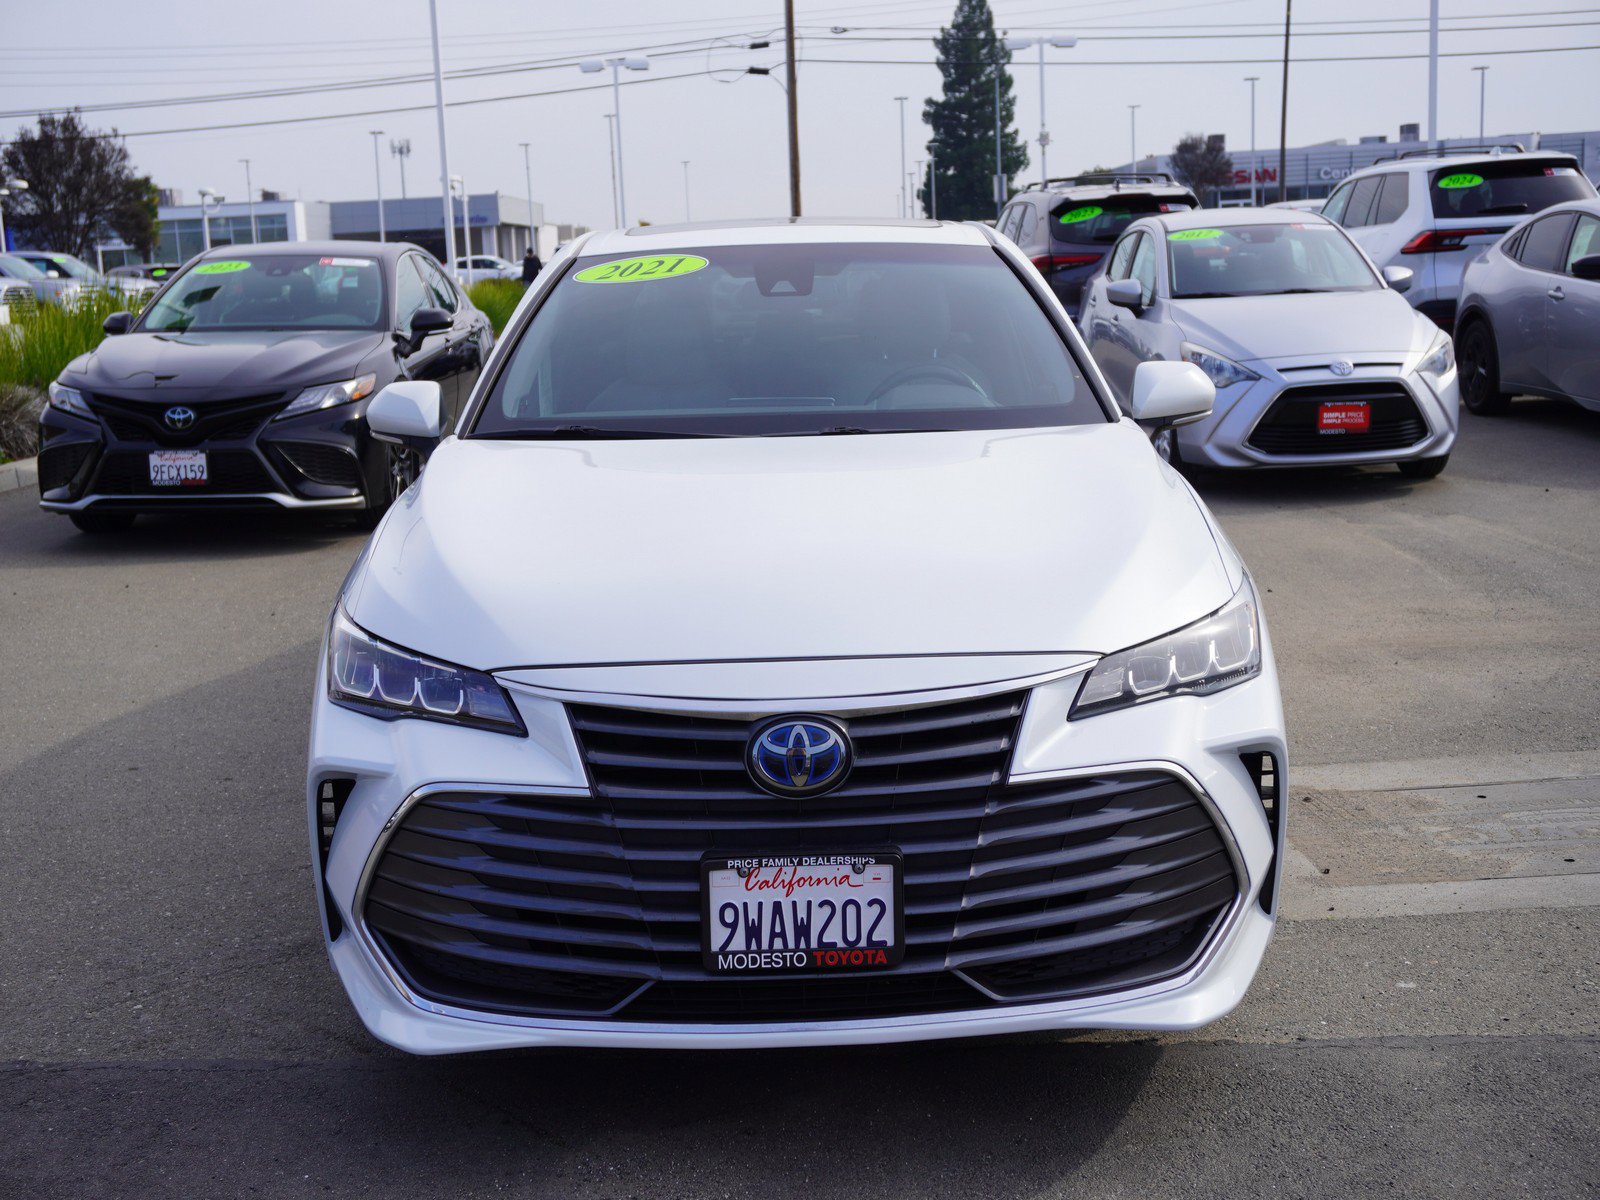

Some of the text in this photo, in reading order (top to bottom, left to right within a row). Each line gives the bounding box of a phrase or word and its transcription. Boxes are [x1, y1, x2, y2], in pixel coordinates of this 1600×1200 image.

[1216, 168, 1277, 184] SAN
[595, 257, 686, 280] 2021
[152, 464, 205, 481] 9FCX159
[152, 479, 181, 487] MODESTO
[727, 856, 876, 869] PRICE FAMILY DEALERSHIPS
[744, 867, 864, 898] California
[718, 898, 888, 951] 9WAW202
[718, 950, 888, 970] MODESTO TOYOTA
